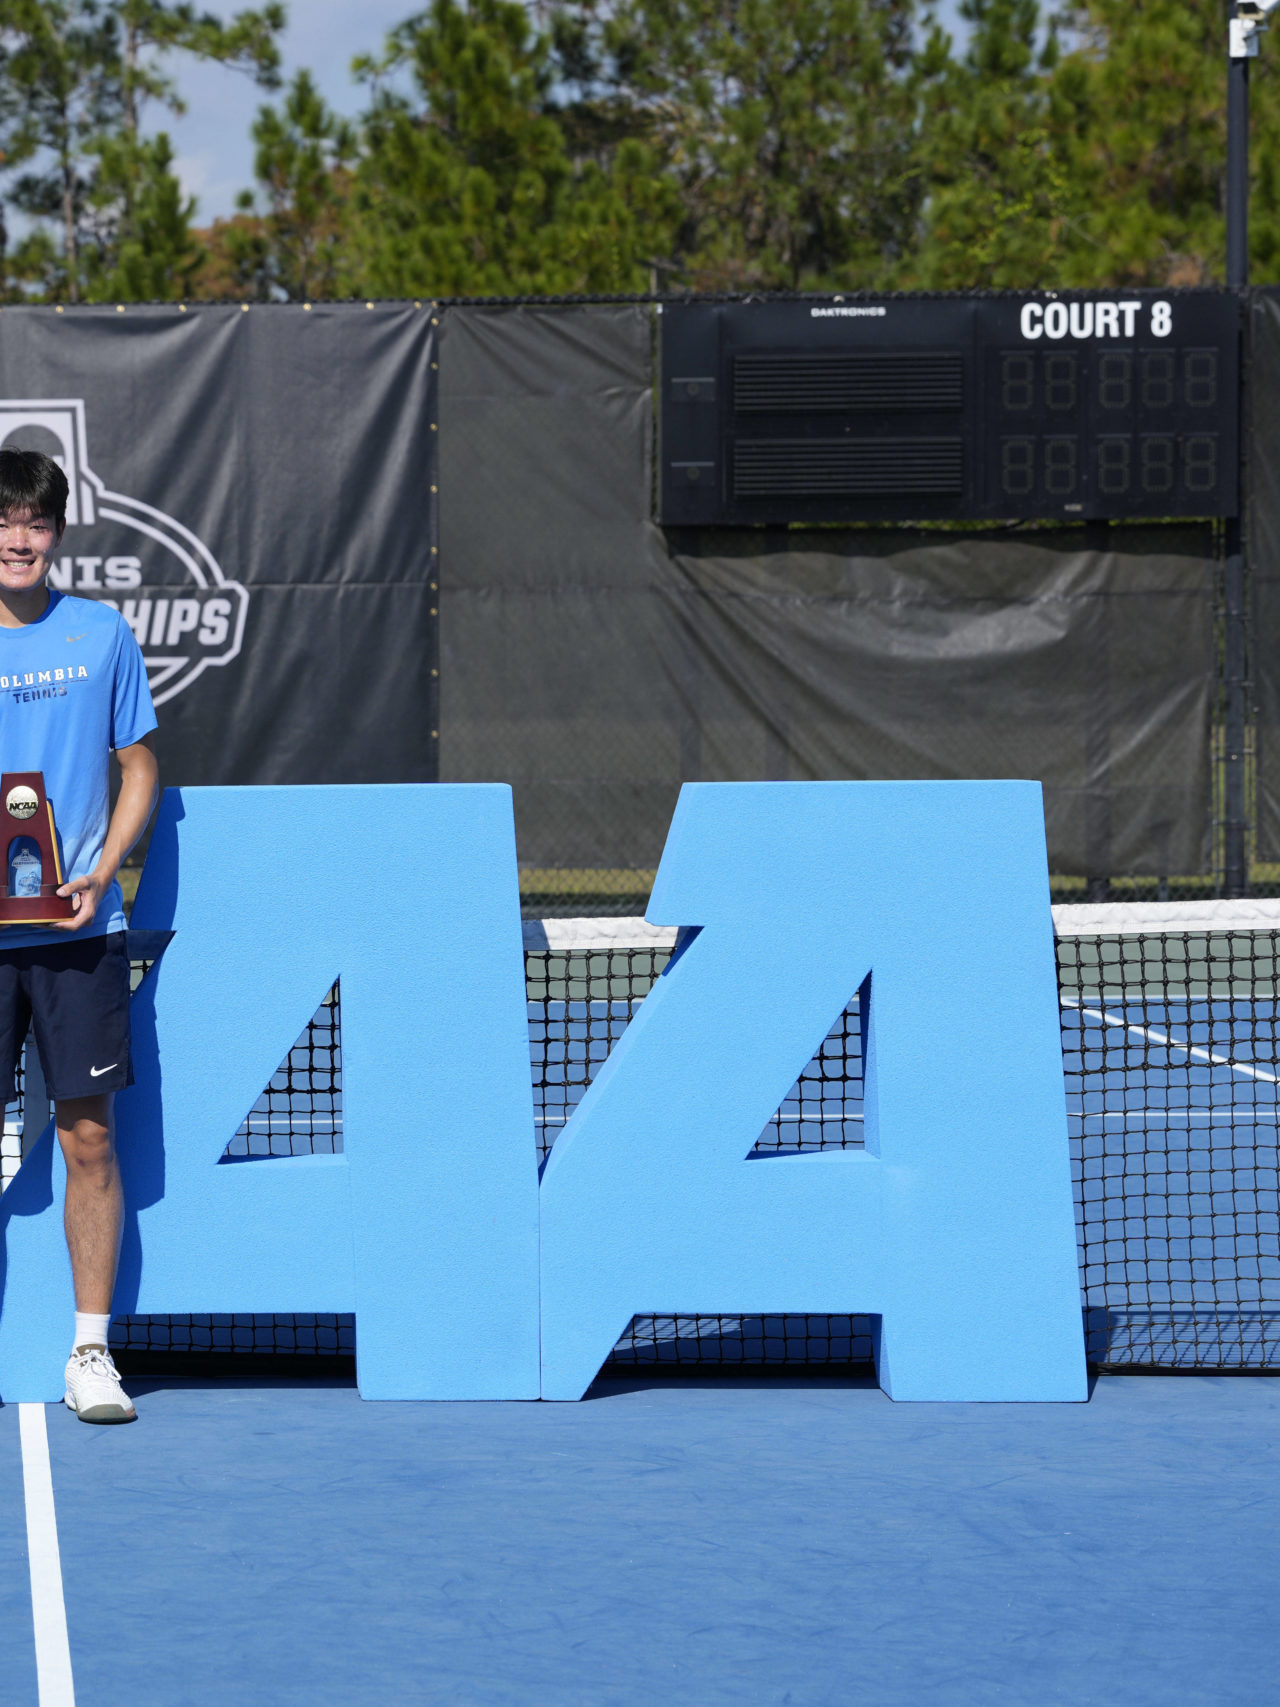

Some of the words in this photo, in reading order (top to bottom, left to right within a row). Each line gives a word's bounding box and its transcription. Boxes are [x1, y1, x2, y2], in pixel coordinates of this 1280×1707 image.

[810, 306, 886, 317] DAKTRONICS
[1020, 301, 1142, 340] COURT
[1150, 300, 1173, 338] 8
[12, 686, 68, 704] TENNIS
[9, 802, 38, 811] NCAA
